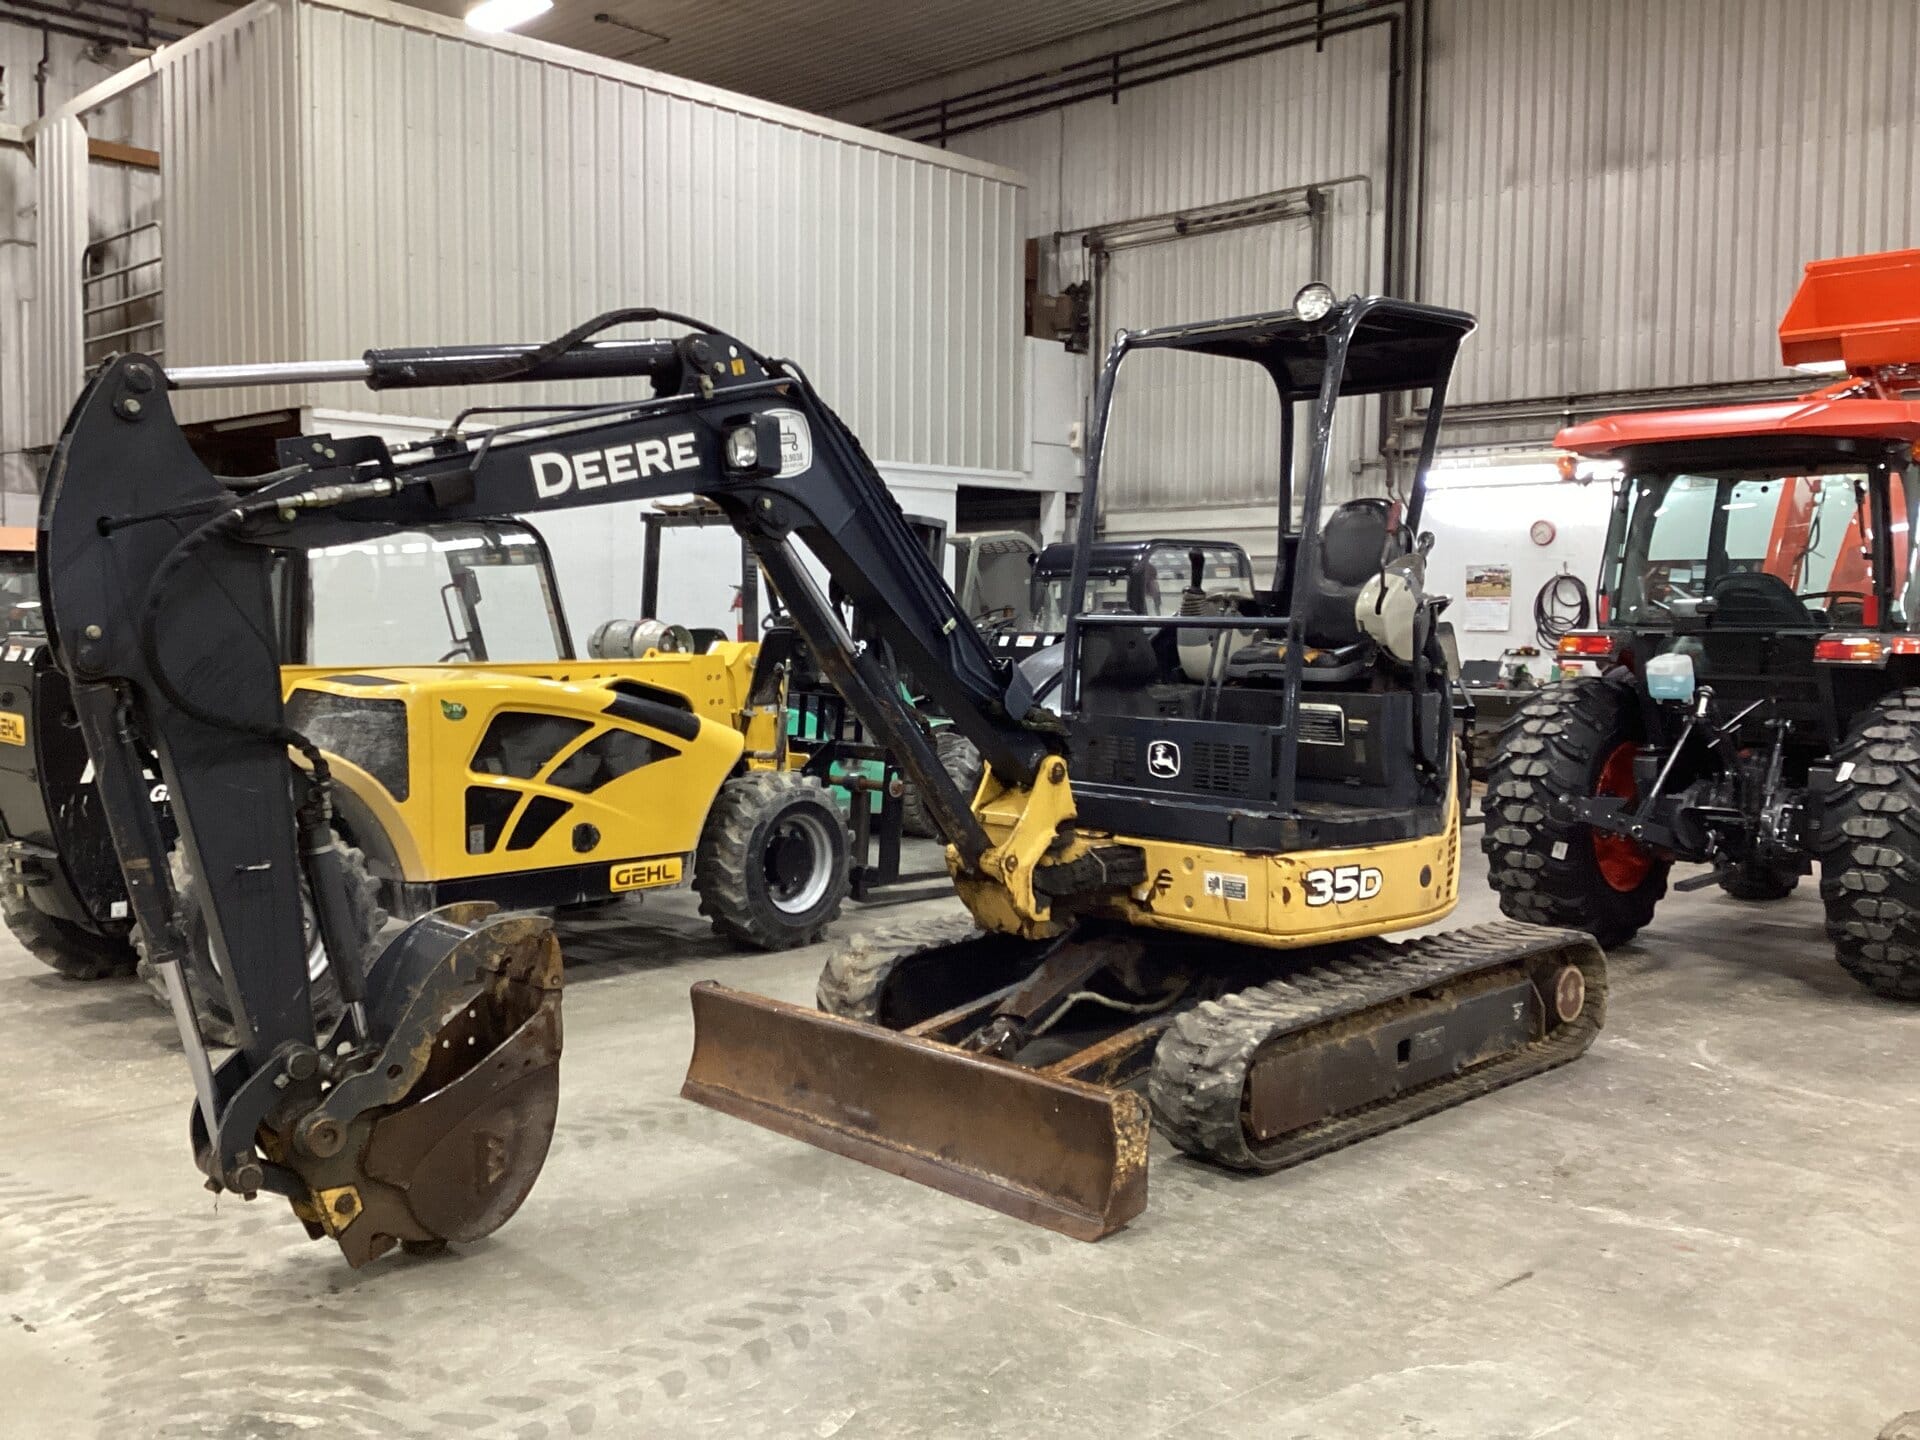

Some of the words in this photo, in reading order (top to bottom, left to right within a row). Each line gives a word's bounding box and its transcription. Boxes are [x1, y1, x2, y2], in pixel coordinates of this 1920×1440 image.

[530, 432, 700, 498] DEERE
[0, 718, 22, 739] EHL
[149, 783, 171, 803] G
[615, 864, 675, 886] GEHL
[1305, 864, 1383, 908] 35D
